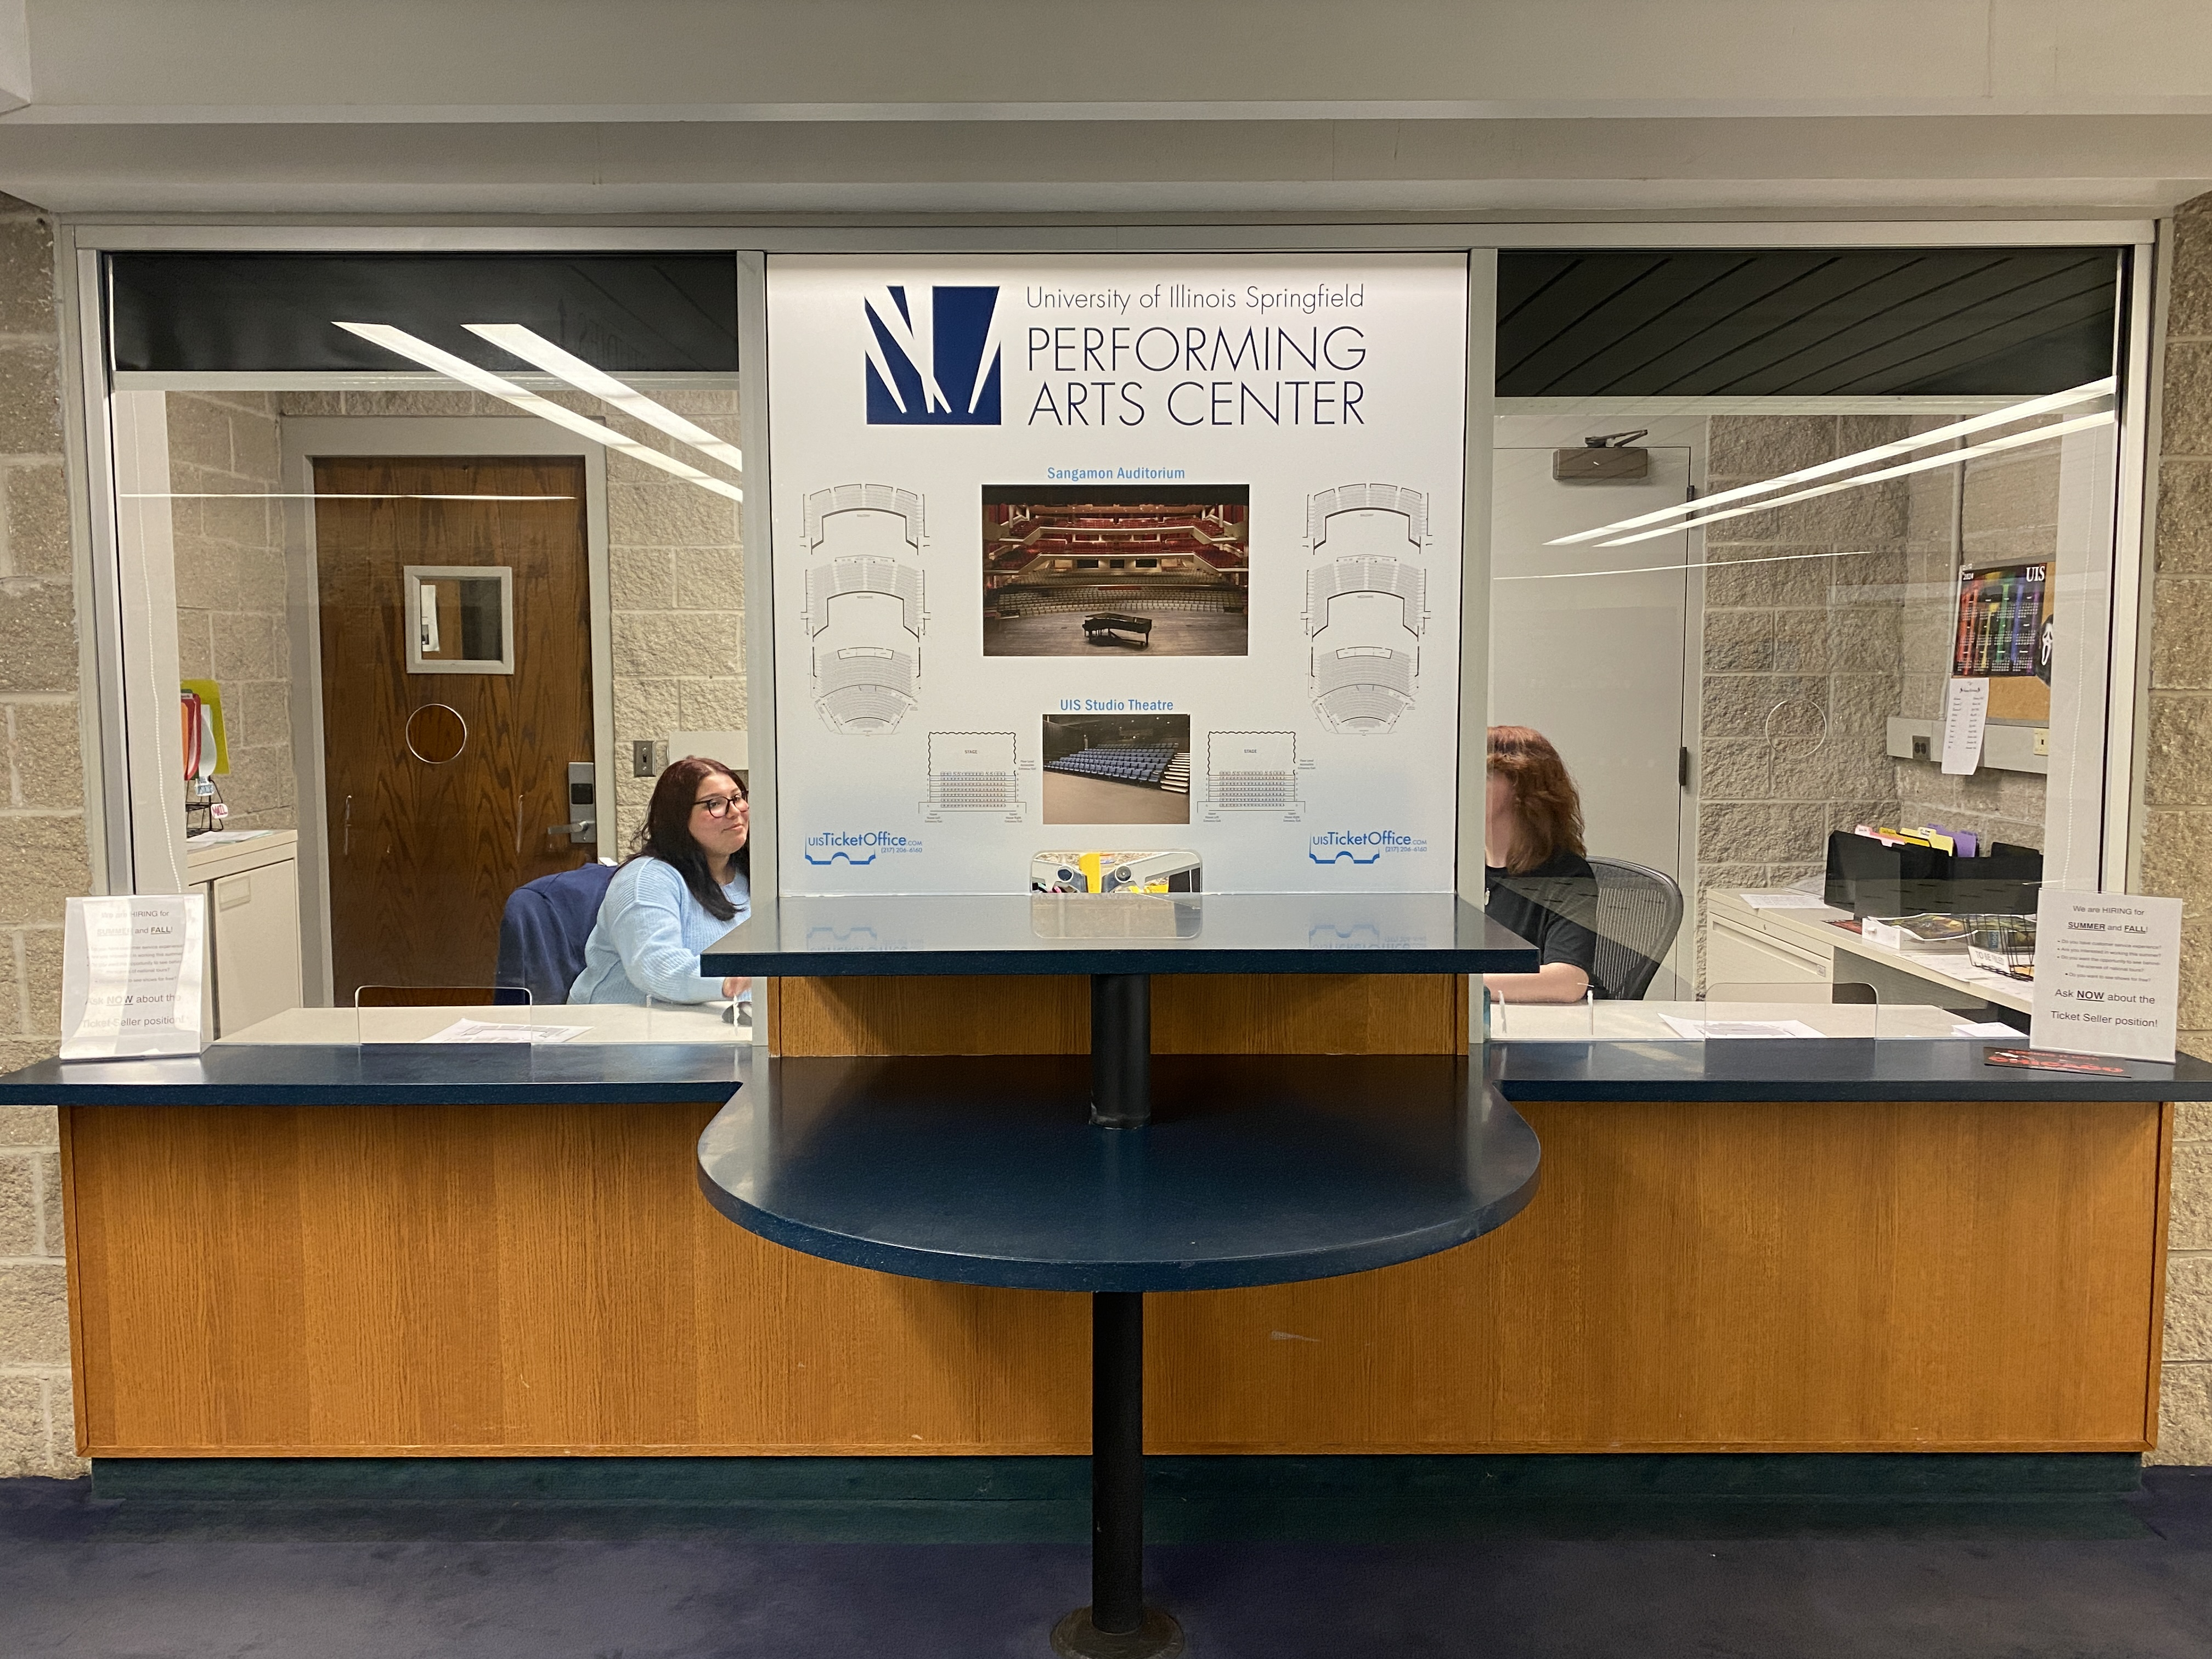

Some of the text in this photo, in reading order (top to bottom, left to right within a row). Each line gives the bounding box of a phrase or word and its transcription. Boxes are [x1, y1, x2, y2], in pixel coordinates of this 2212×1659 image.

[1026, 284, 1364, 315] University of Illinois Springfield
[1029, 326, 1367, 372] PERFORMING
[1028, 382, 1365, 426] ARTS CENTER
[1047, 466, 1185, 481] Sangamon Auditorium
[2027, 566, 2045, 582] UIS
[1060, 699, 1173, 710] UIS Studio Theatre
[1975, 951, 1983, 959] TO
[136, 995, 162, 1003] about
[2055, 989, 2155, 1004] Ask NOW about the
[2051, 1011, 2158, 1028] Ticket Seller position!
